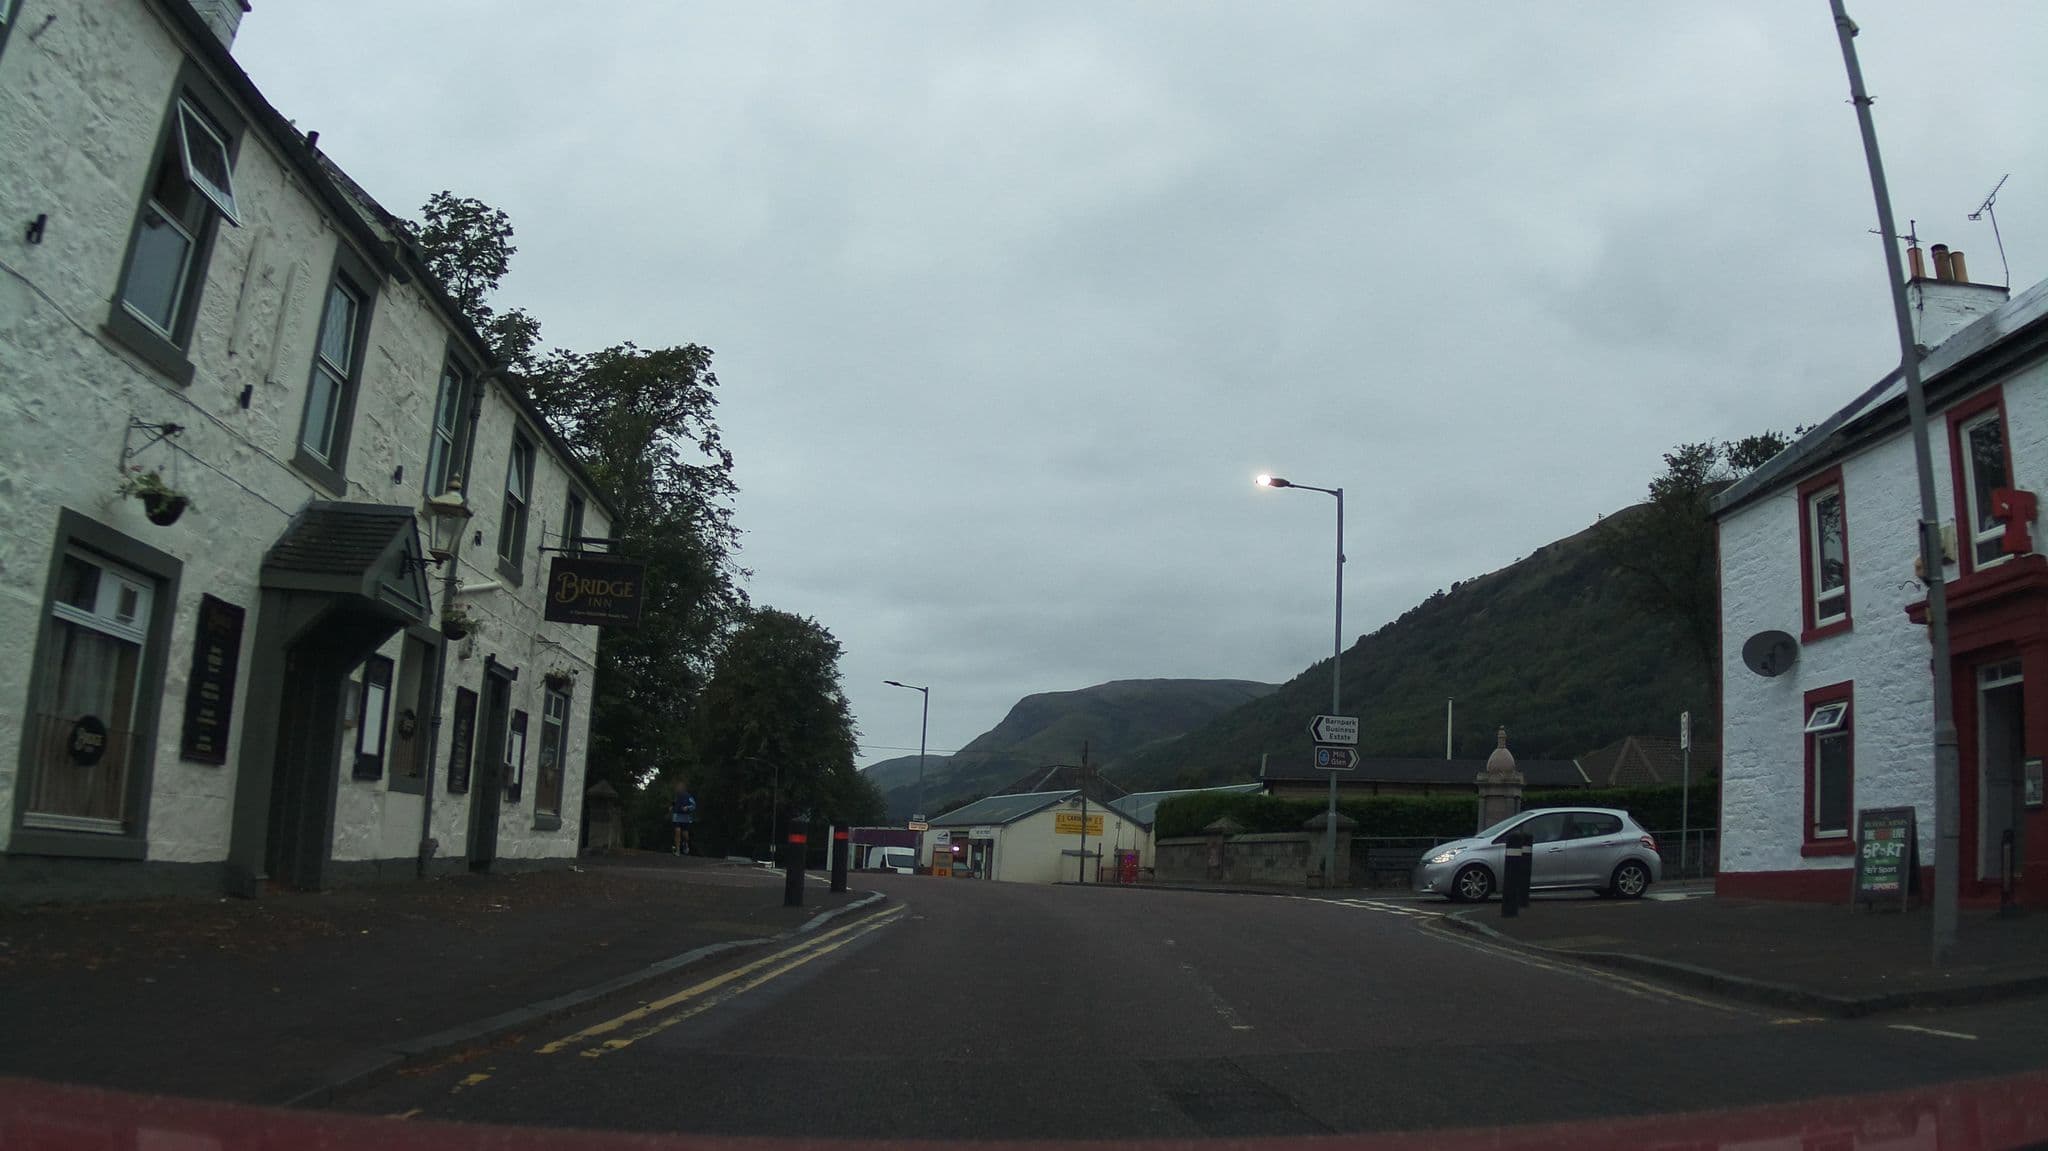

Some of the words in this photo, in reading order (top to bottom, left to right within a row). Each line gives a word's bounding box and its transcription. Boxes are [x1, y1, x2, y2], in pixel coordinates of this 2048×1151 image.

[555, 571, 634, 603] BRIDGE
[588, 597, 612, 609] INN
[1325, 718, 1356, 727] Barnpark
[1325, 725, 1356, 733] Business
[1331, 758, 1347, 766] Glen
[1863, 843, 1905, 859] SPORT
